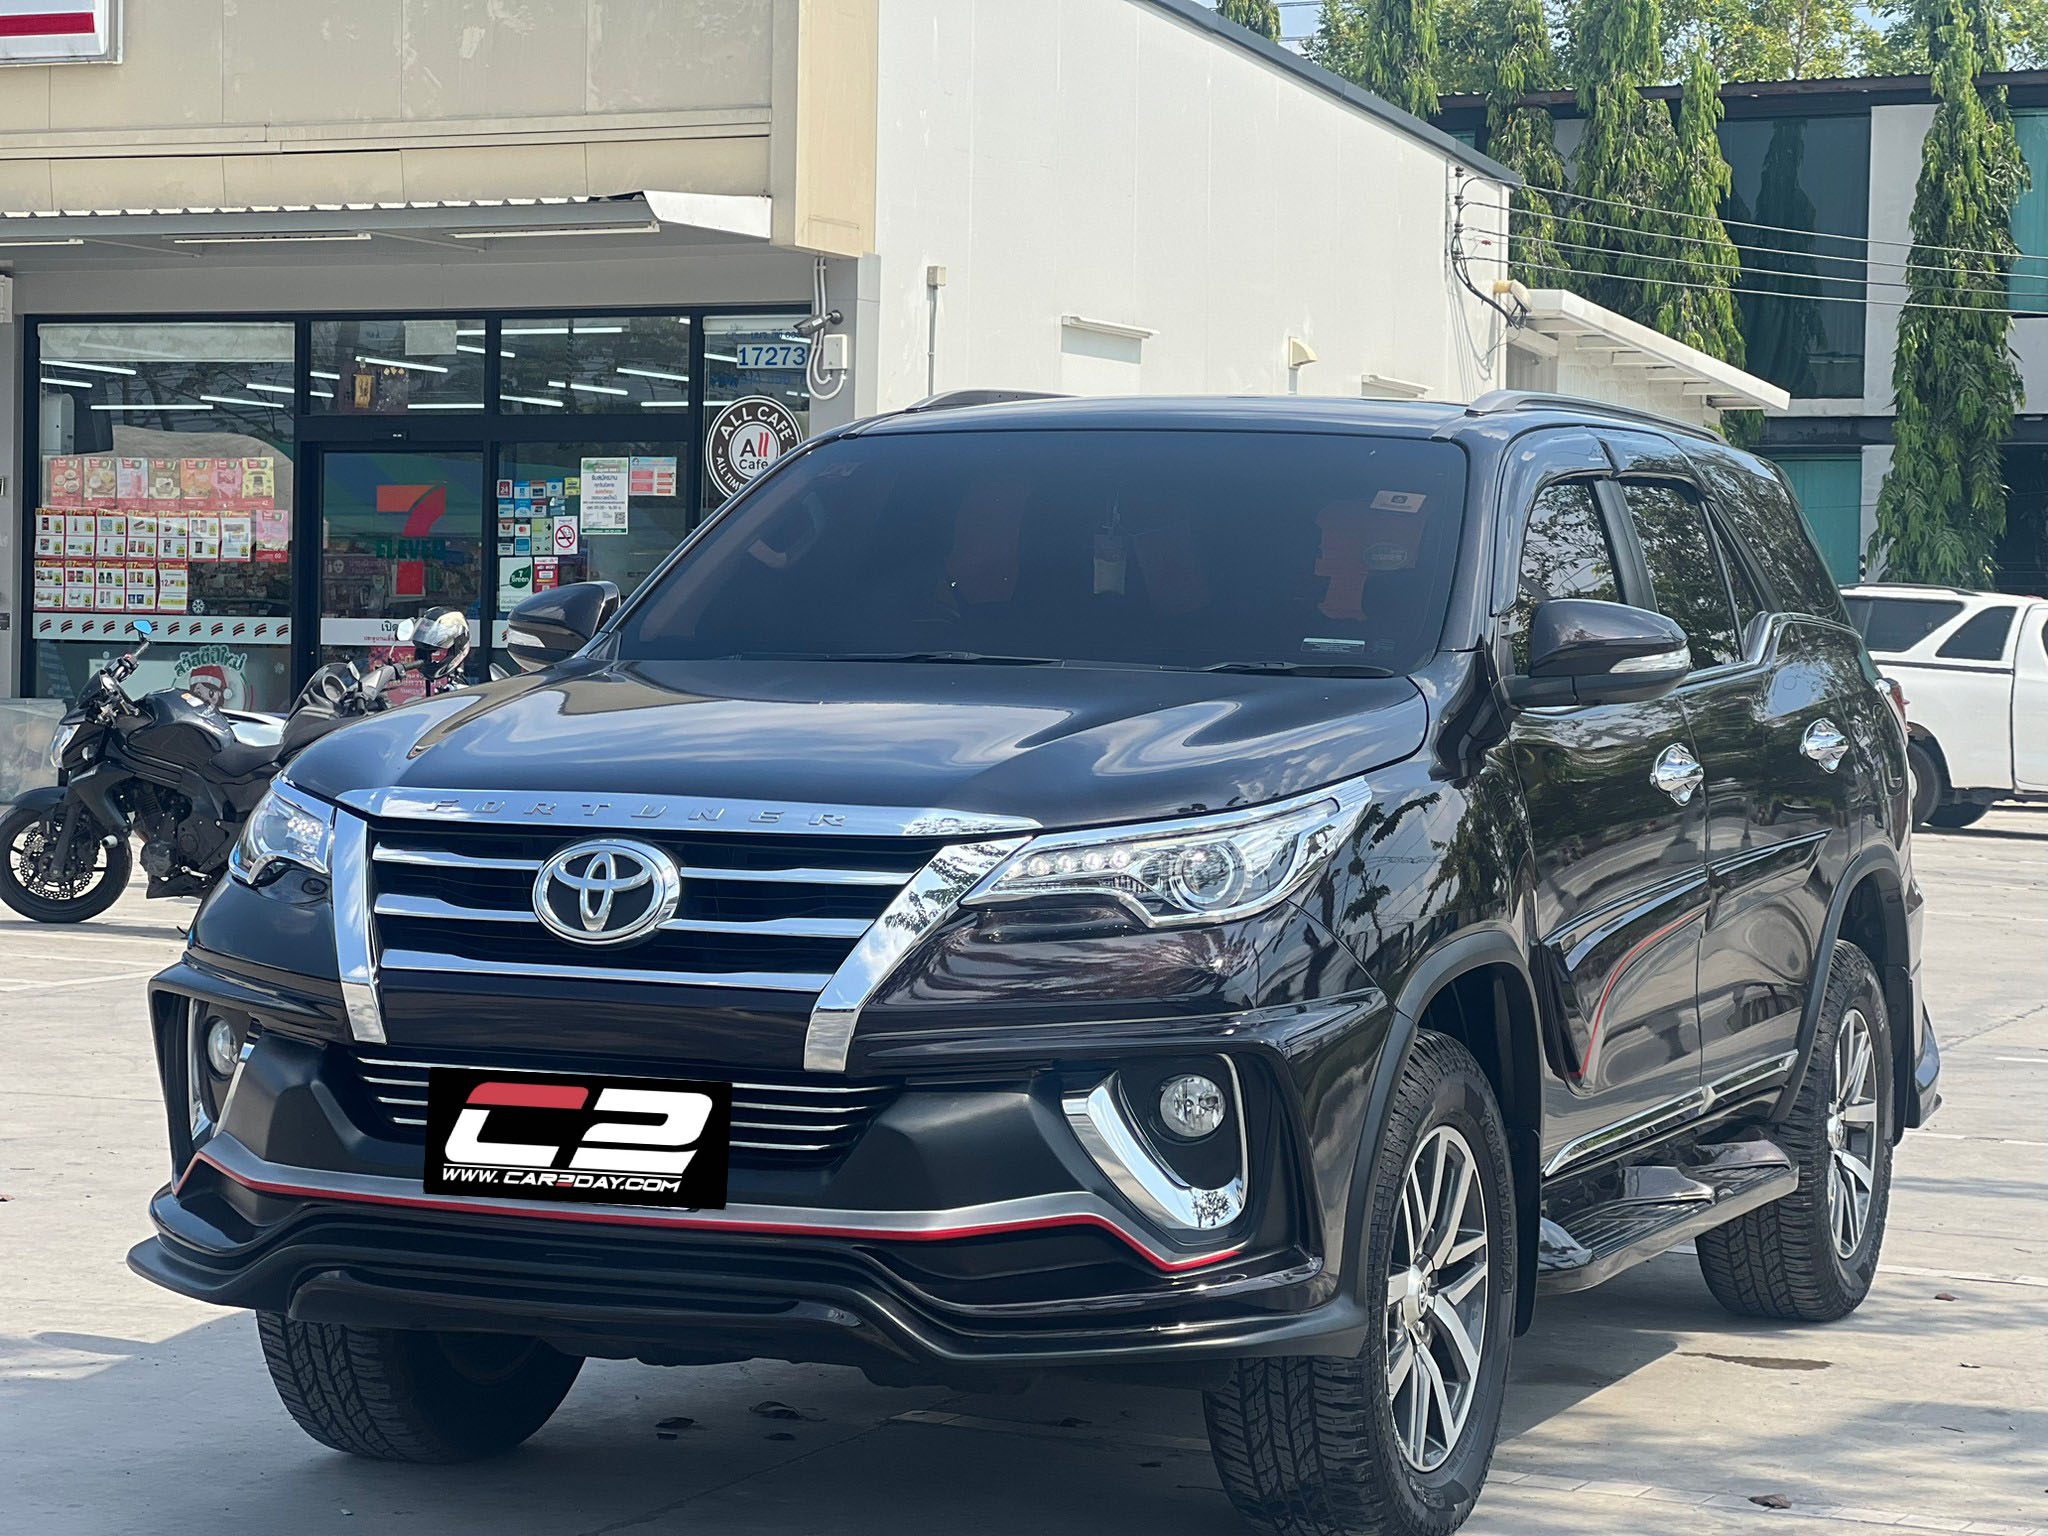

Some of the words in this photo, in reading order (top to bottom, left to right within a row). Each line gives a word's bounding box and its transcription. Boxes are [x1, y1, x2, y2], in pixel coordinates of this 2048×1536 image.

[738, 346, 806, 366] 17273
[720, 407, 753, 440] ALL
[739, 432, 770, 458] All
[715, 457, 728, 475] ALL
[173, 645, 248, 677] สวัสดีปีใหม่
[427, 799, 847, 827] FORTUNER
